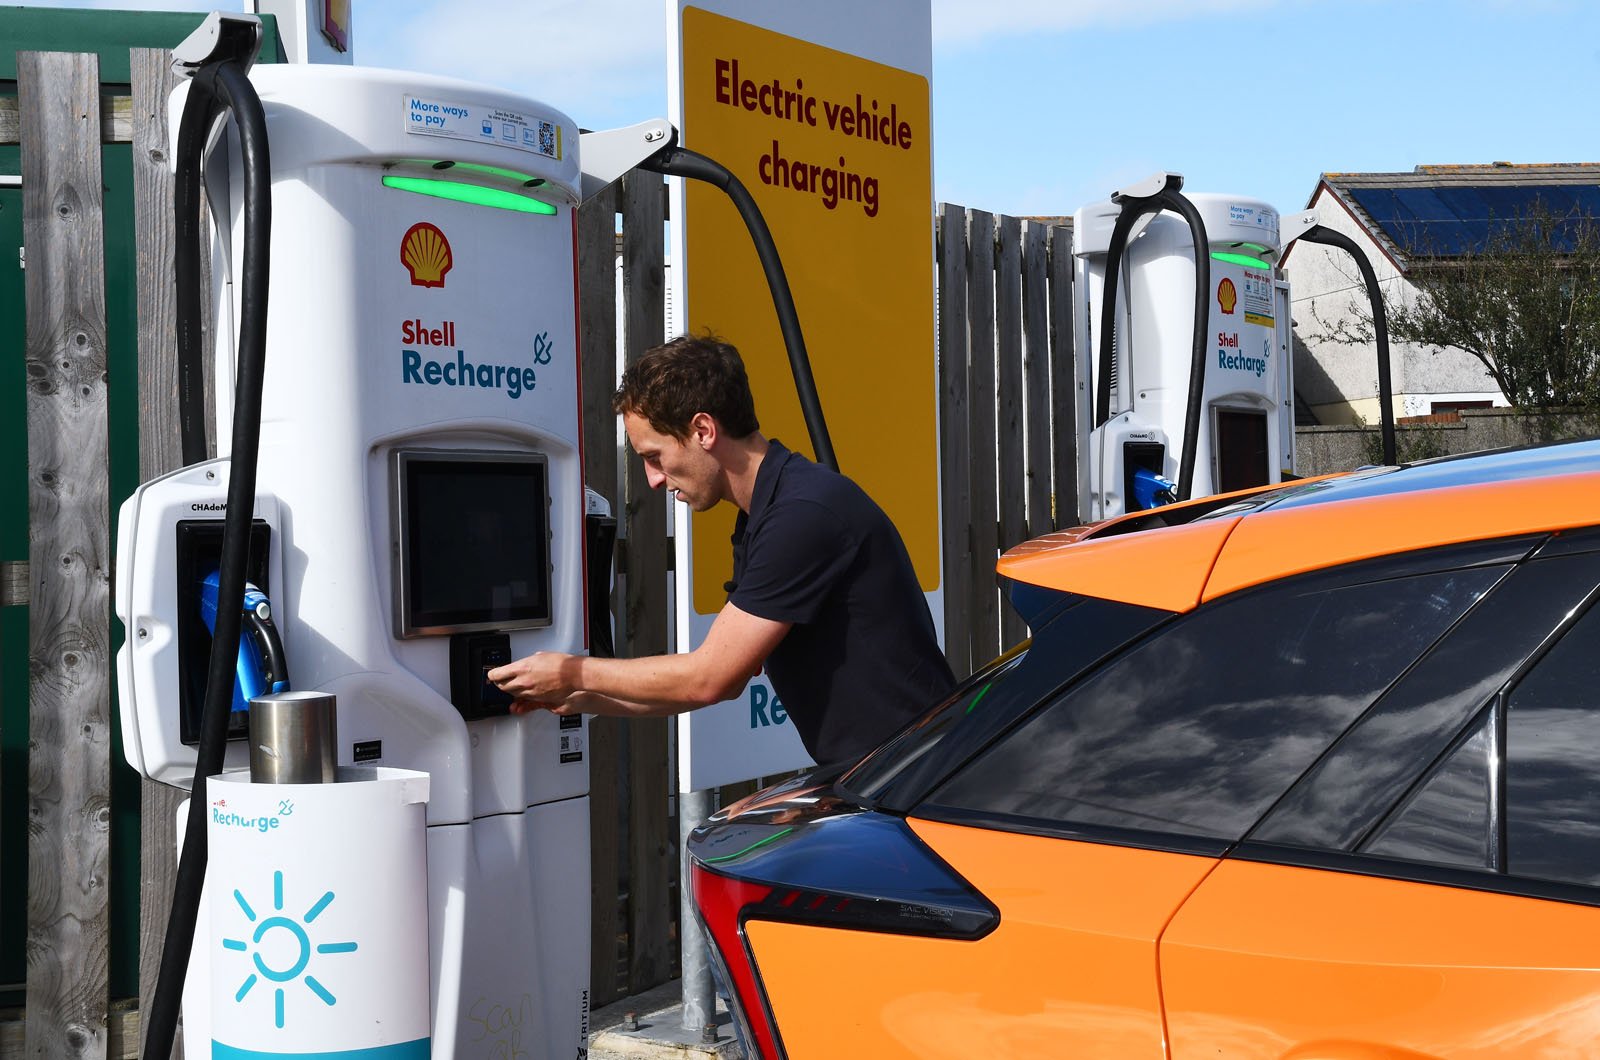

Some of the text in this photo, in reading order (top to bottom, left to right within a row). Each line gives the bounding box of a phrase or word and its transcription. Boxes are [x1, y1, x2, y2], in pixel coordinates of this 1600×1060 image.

[411, 98, 469, 119] More ways
[715, 58, 912, 150] Electric vehicle
[411, 111, 446, 128] to pay
[758, 139, 879, 218] charging
[1230, 204, 1243, 213] More
[402, 319, 455, 347] Shell
[1218, 331, 1239, 348] Shell
[402, 349, 536, 400] Recharge
[1218, 349, 1266, 378] Recharge
[923, 905, 954, 917] VISION
[468, 993, 534, 1043] Scan
[580, 990, 588, 1042] TRITIUM
